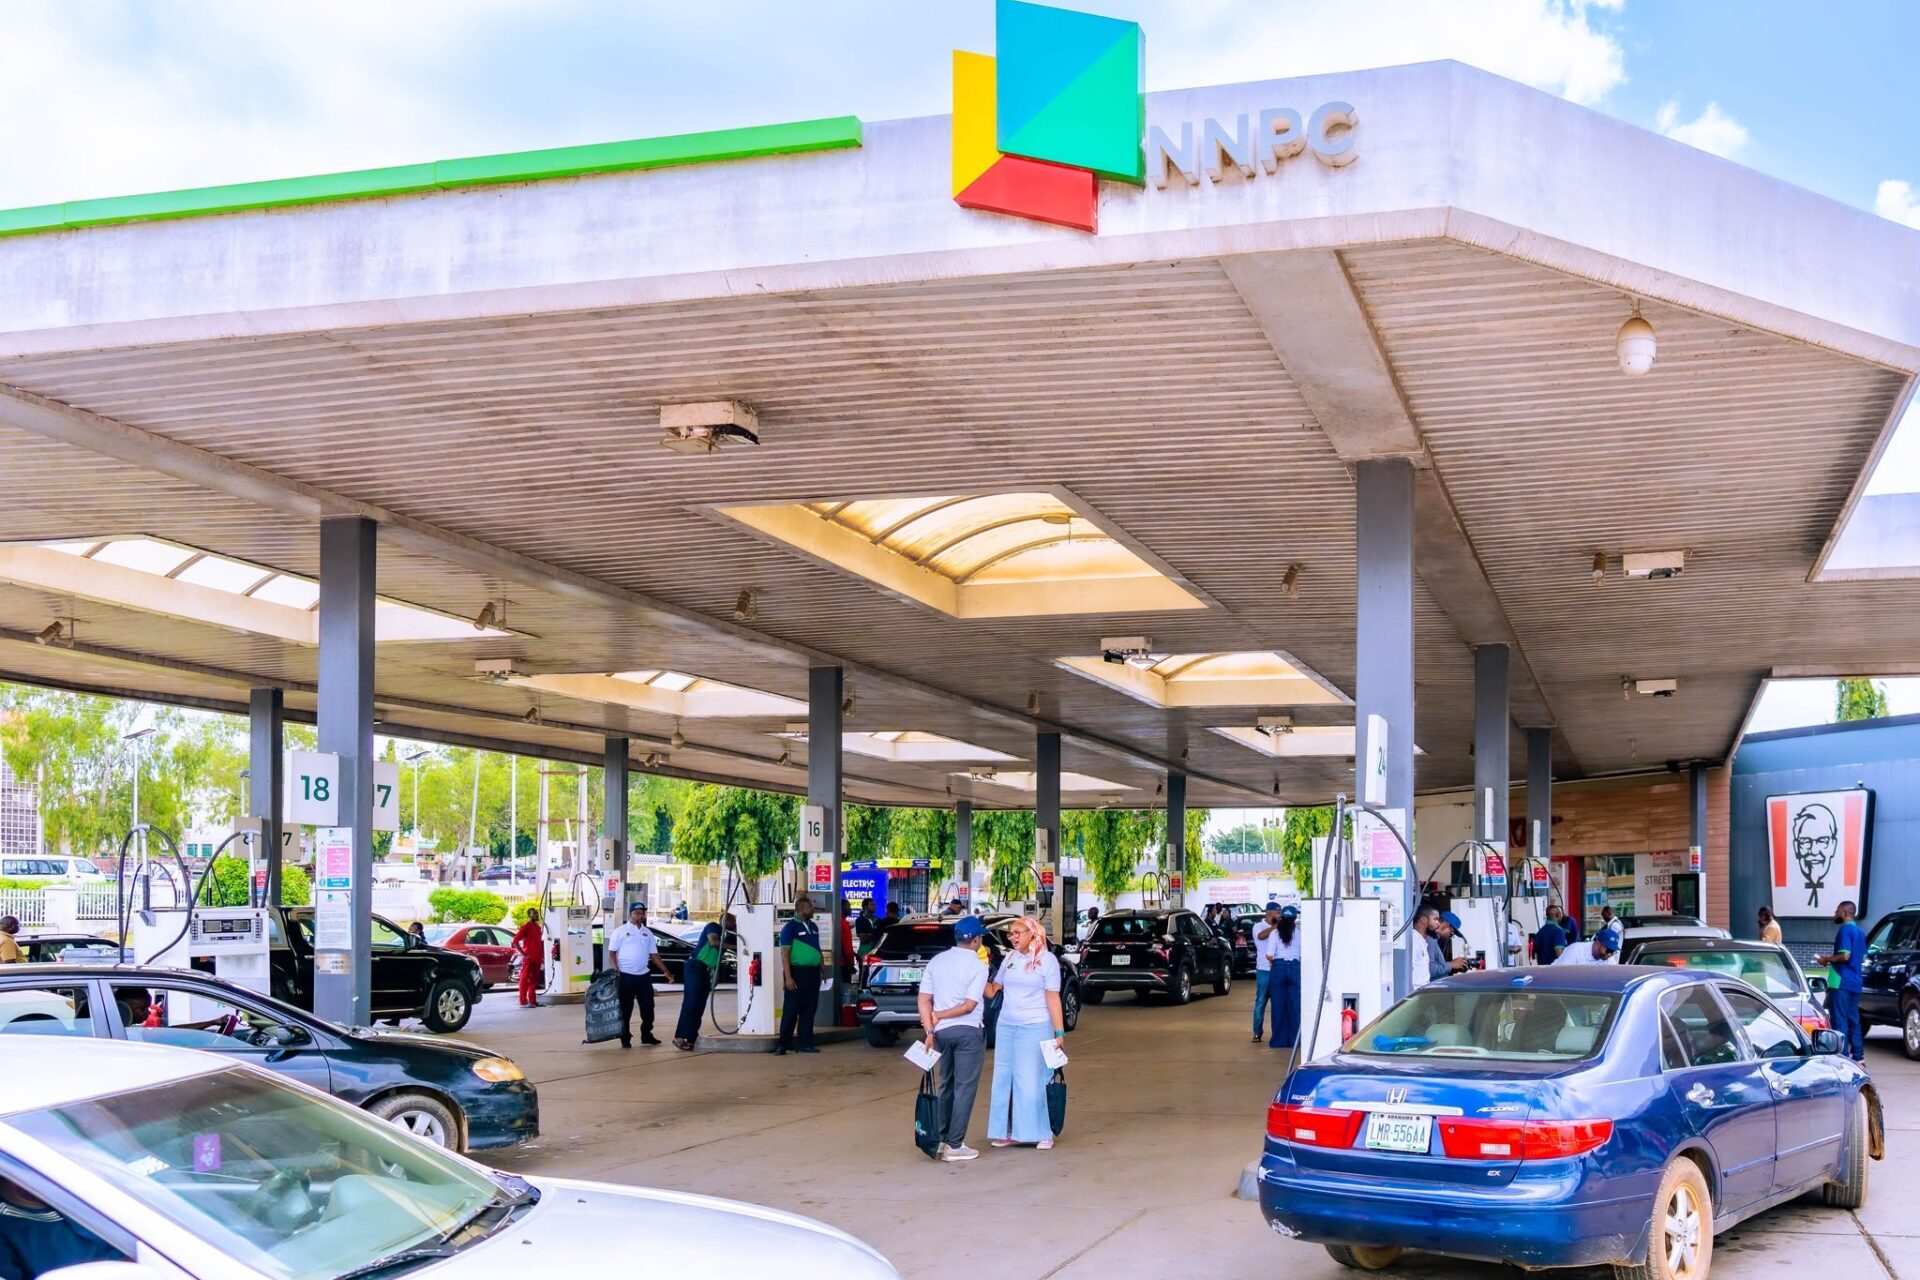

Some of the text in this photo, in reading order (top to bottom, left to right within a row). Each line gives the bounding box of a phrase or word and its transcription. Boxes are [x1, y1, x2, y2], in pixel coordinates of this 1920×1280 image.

[1147, 101, 1359, 190] NNPC
[1378, 745, 1387, 777] 24
[300, 775, 330, 802] 18
[373, 784, 392, 808] 7
[808, 820, 820, 837] 16
[605, 849, 610, 860] 6
[842, 879, 875, 889] ELECTRIC
[844, 890, 873, 899] VEHICLE
[1370, 1122, 1426, 1144] LMR-556AA
